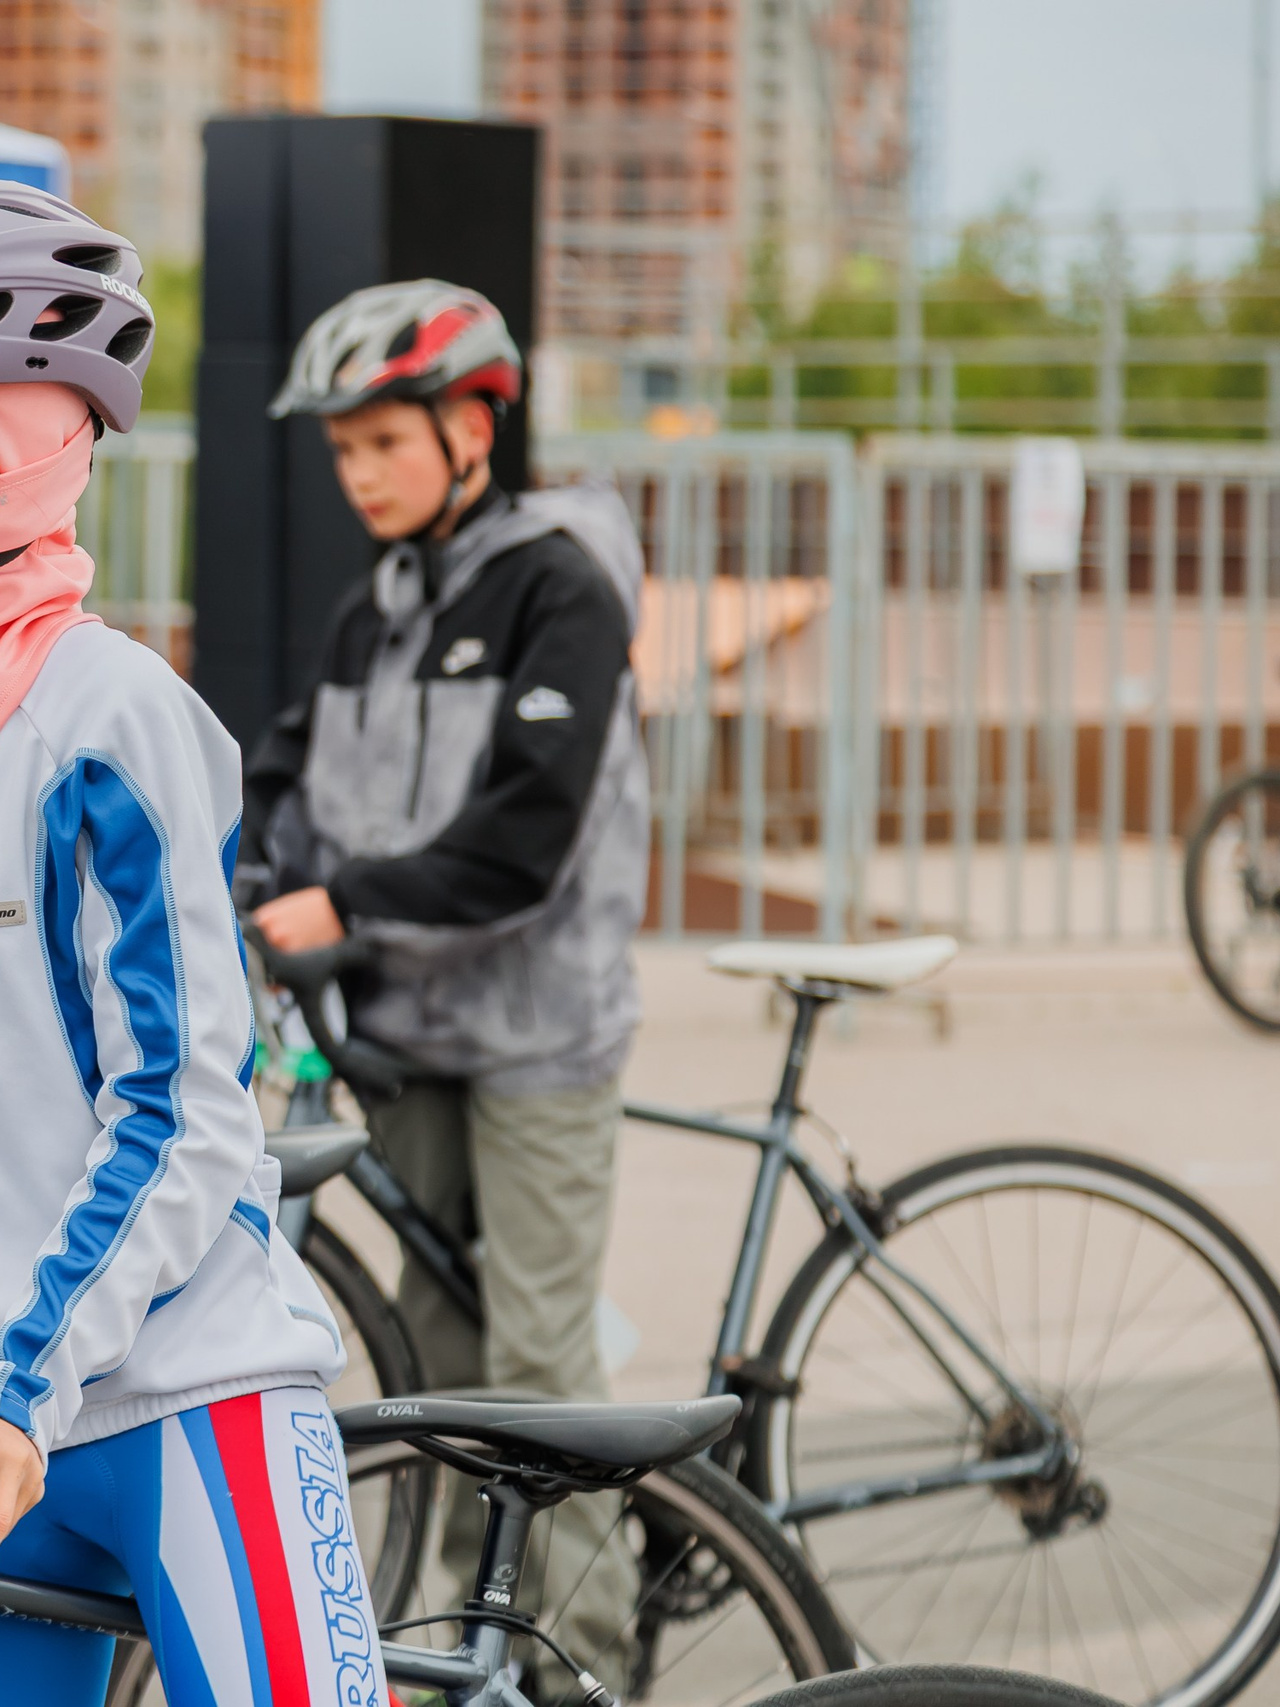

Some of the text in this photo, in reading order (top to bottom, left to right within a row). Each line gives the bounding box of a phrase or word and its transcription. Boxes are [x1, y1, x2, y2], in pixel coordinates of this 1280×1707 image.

[377, 1404, 423, 1418] OVAL
[291, 1411, 378, 1707] RUSSIA
[483, 1590, 511, 1606] OVA
